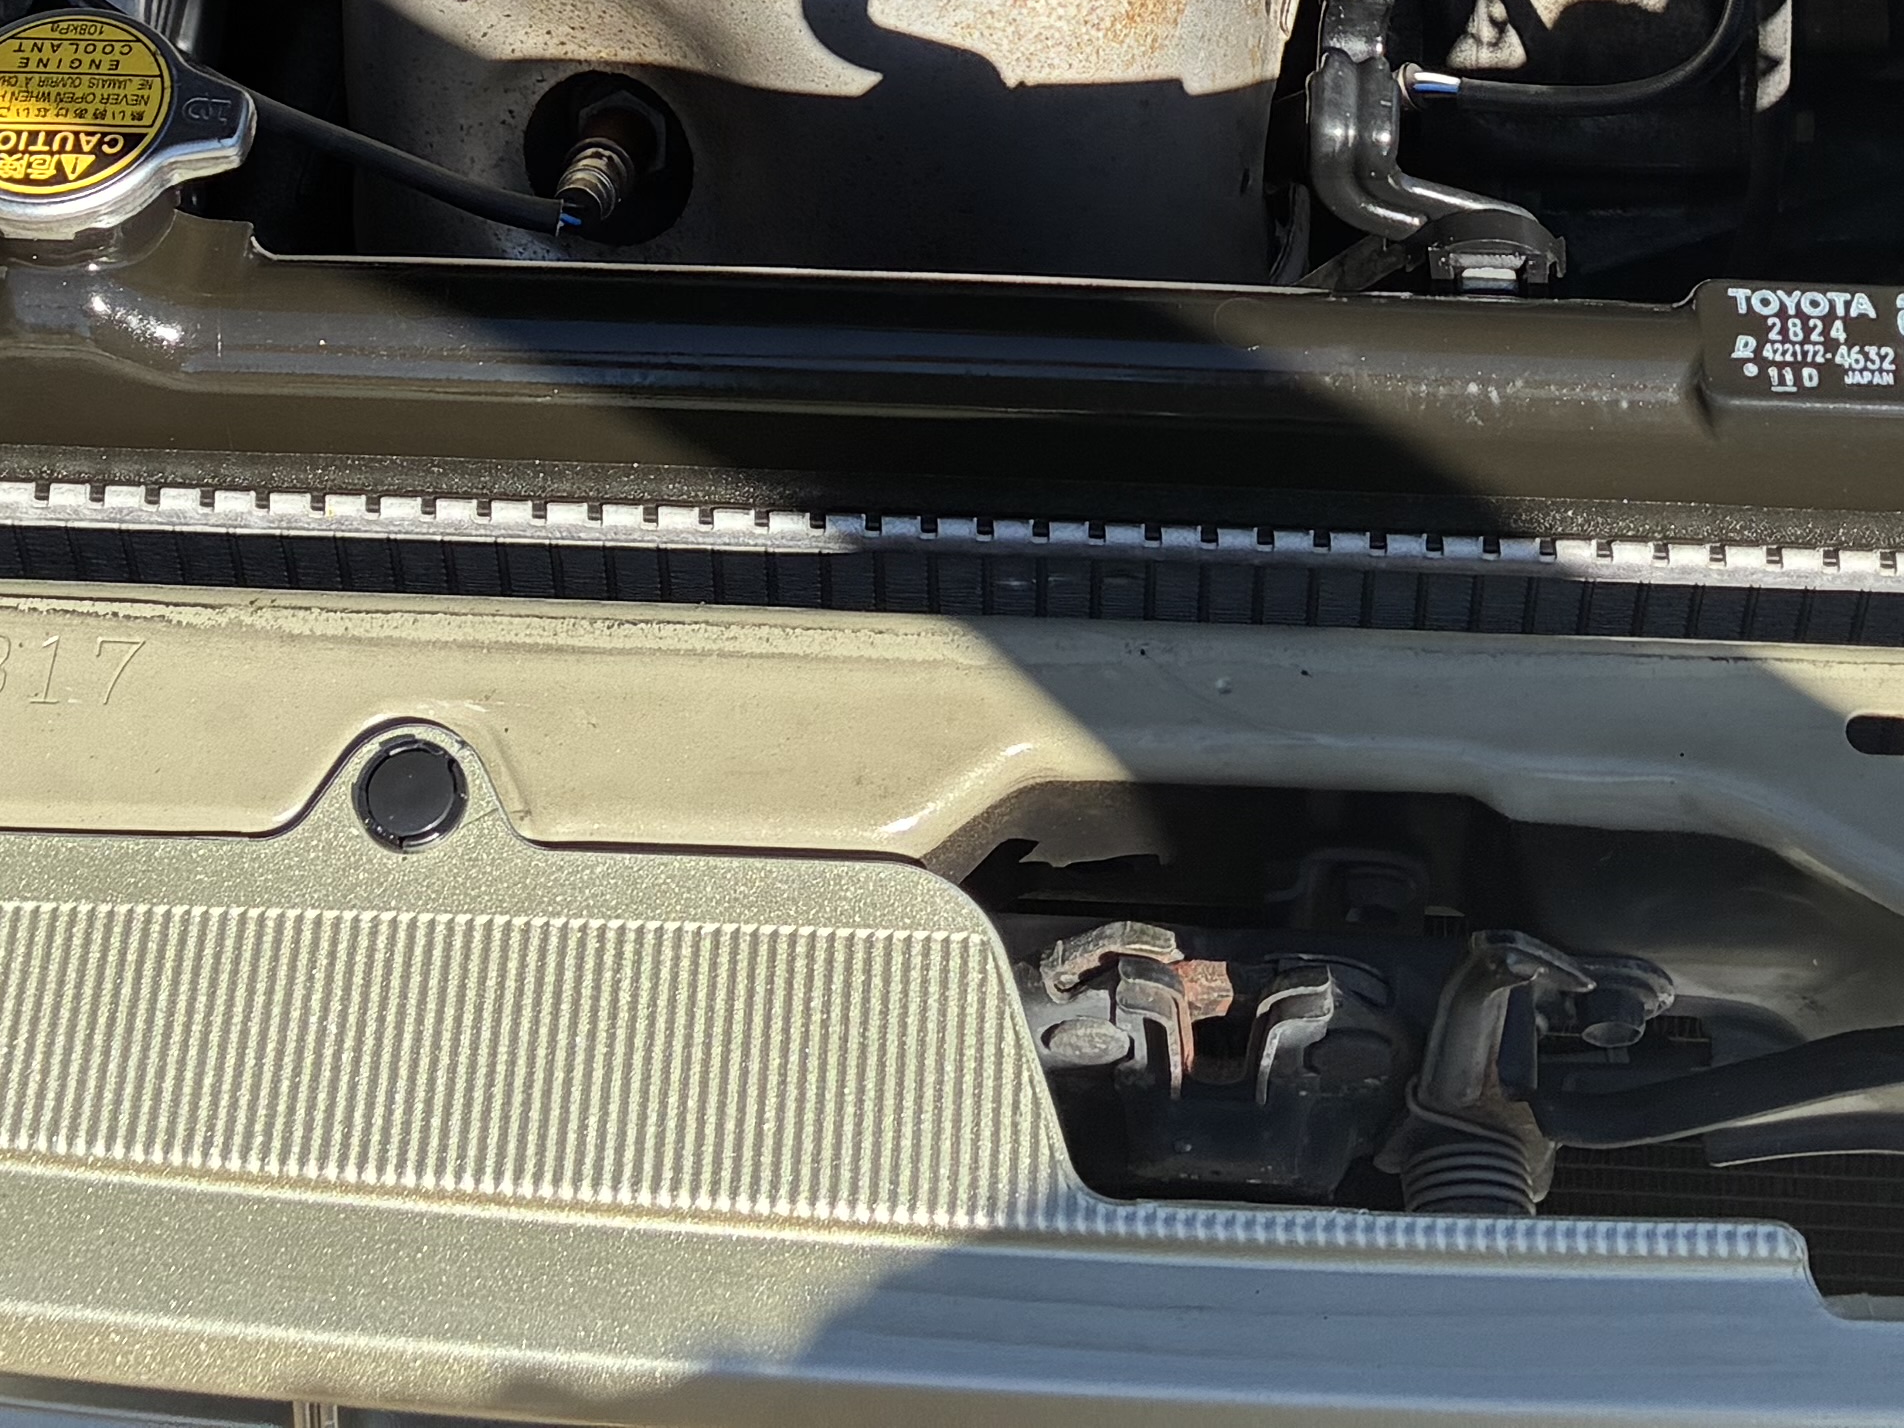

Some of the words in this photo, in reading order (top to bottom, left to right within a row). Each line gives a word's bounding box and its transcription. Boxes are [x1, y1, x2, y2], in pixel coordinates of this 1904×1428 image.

[49, 23, 105, 36] 108kPa
[13, 42, 133, 56] COOLANT
[18, 57, 120, 70] ENGINE
[39, 76, 83, 89] OUVRIR
[88, 77, 133, 90] JAMAIS
[137, 78, 154, 91] NE
[10, 90, 53, 104] WHEN
[55, 91, 97, 104] OPEN
[99, 92, 151, 105] NEVER
[1727, 287, 1877, 319] TOYOTA
[1767, 316, 1847, 343] 2824
[1762, 342, 1896, 371] 422172-4632
[1844, 370, 1895, 386] JAPAN
